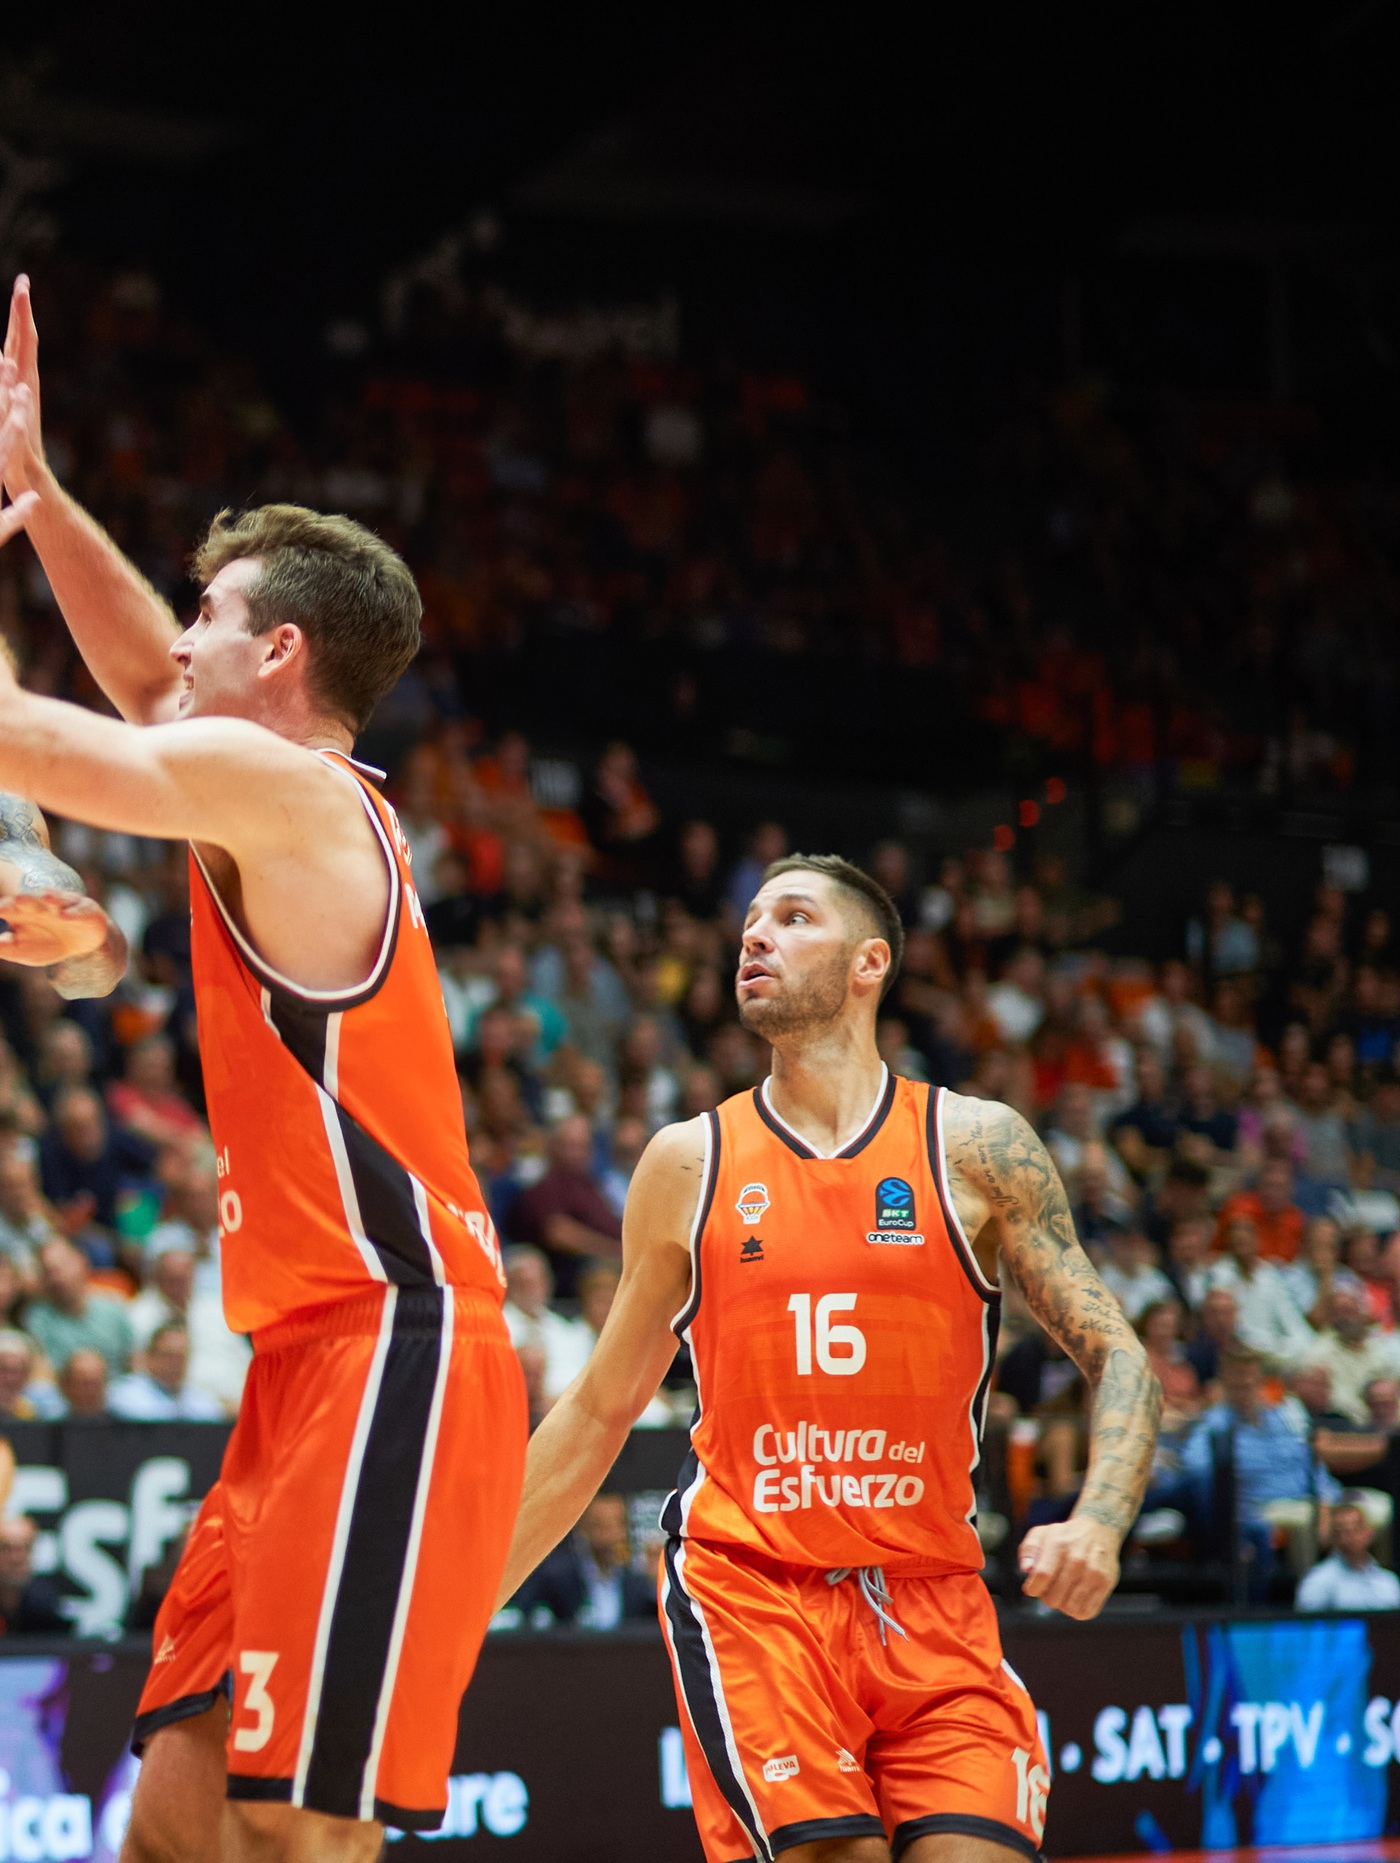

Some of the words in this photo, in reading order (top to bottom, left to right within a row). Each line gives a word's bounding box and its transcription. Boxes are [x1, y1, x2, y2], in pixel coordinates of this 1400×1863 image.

[878, 1218, 914, 1228] EuroCup
[787, 1292, 867, 1376] 16
[753, 1420, 888, 1466] Cultura
[888, 1440, 925, 1464] del
[753, 1464, 925, 1513] Esfuerzo
[233, 1650, 280, 1753] 3
[1090, 1704, 1194, 1784] SAT
[1231, 1699, 1325, 1776] TPV
